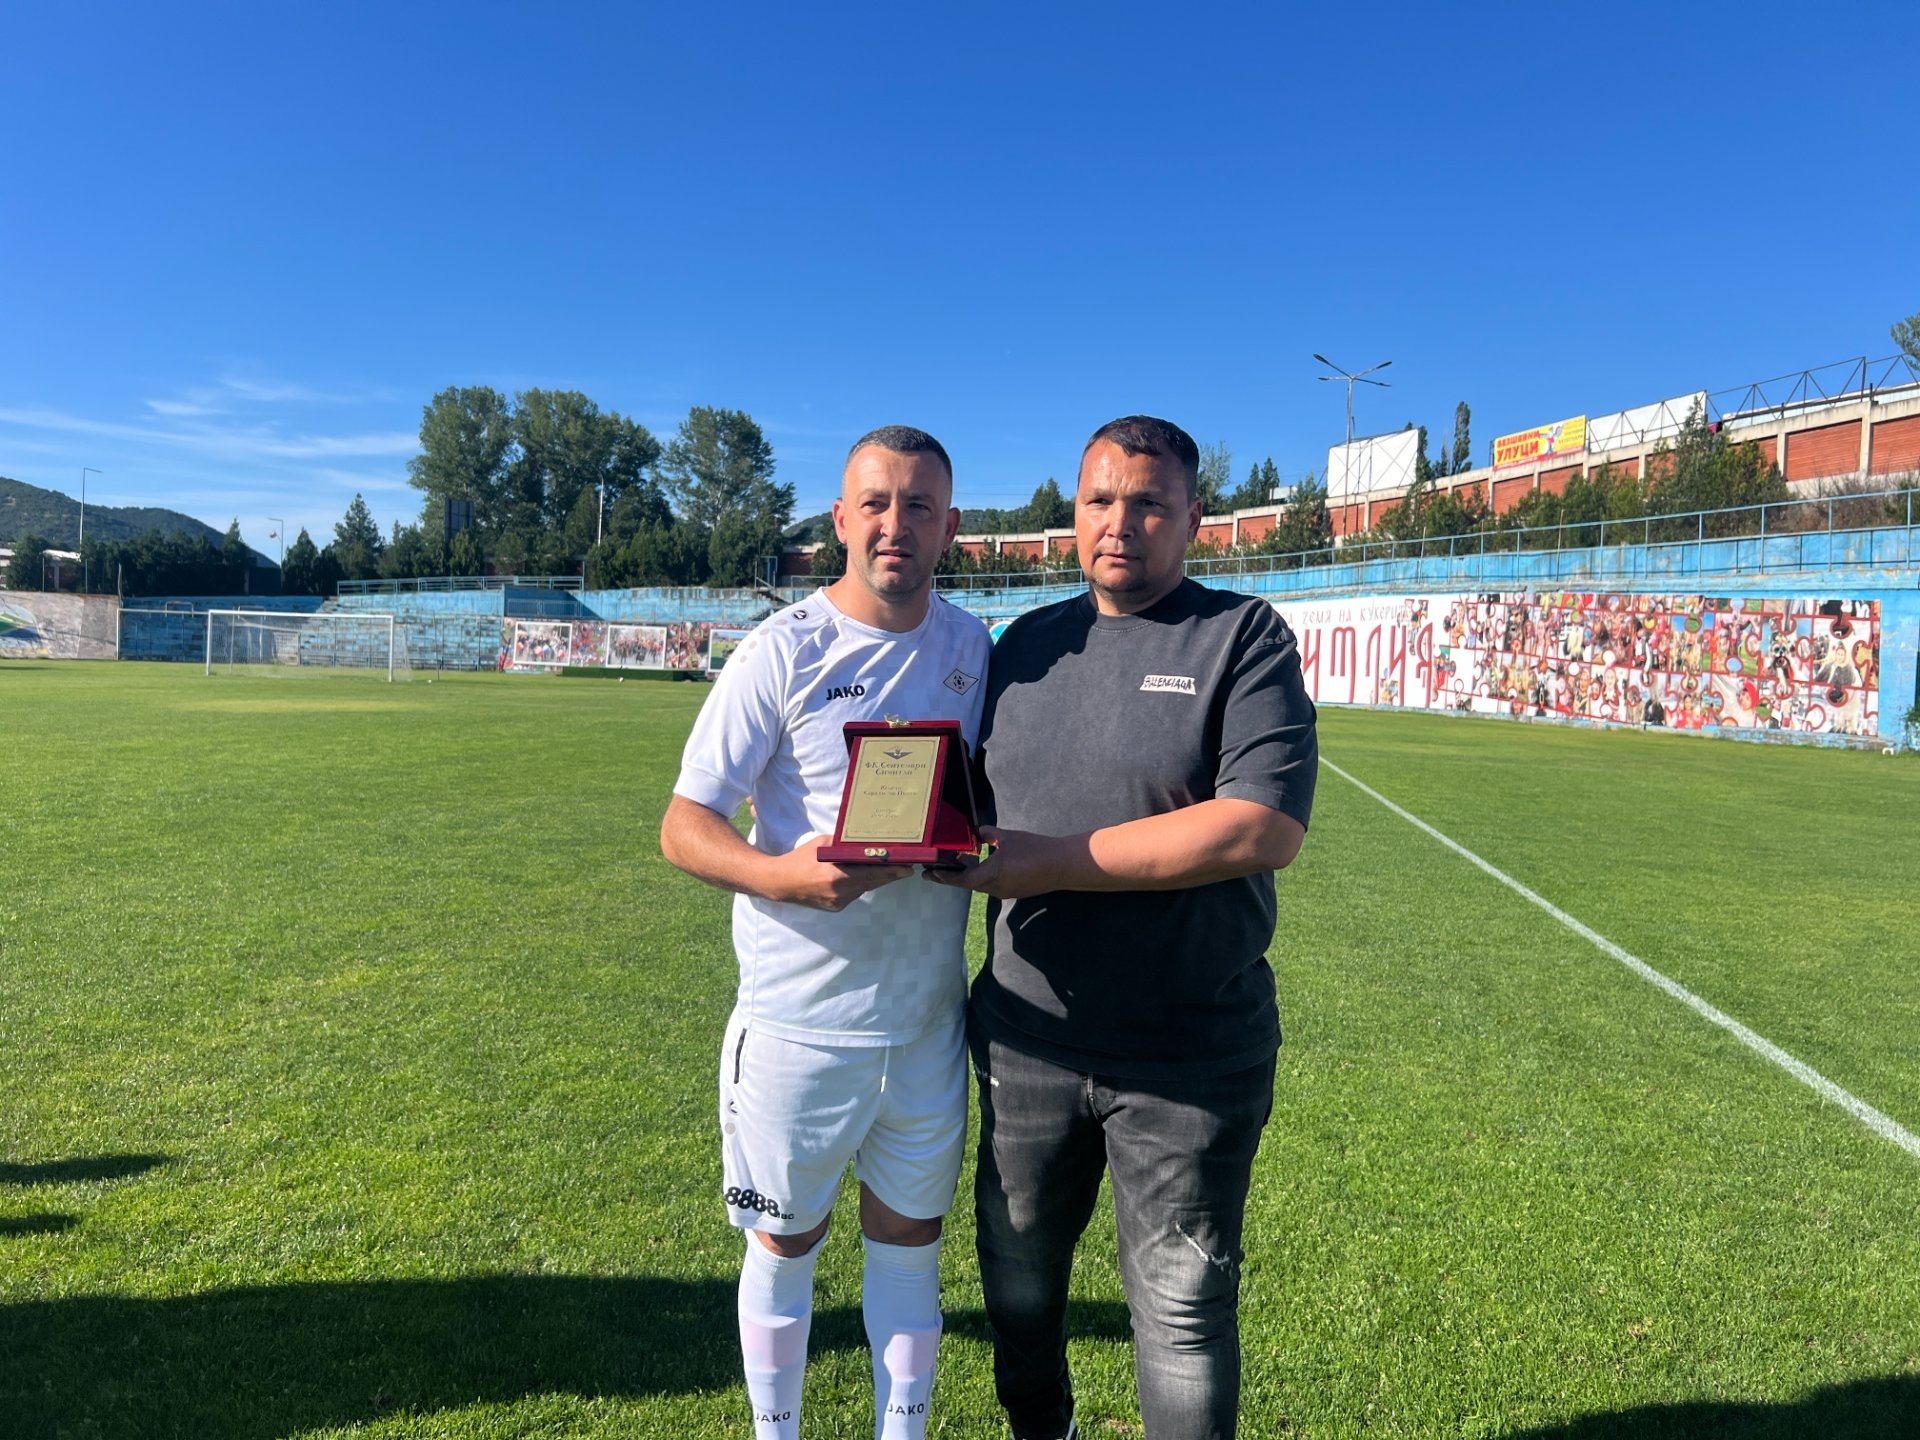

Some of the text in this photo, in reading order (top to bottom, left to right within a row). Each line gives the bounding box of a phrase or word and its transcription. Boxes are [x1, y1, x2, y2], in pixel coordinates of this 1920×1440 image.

[1497, 440, 1539, 463] УЛУЦИ
[825, 684, 866, 701] JAKO
[886, 1402, 925, 1416] JAKO
[755, 1411, 791, 1423] JAKO
